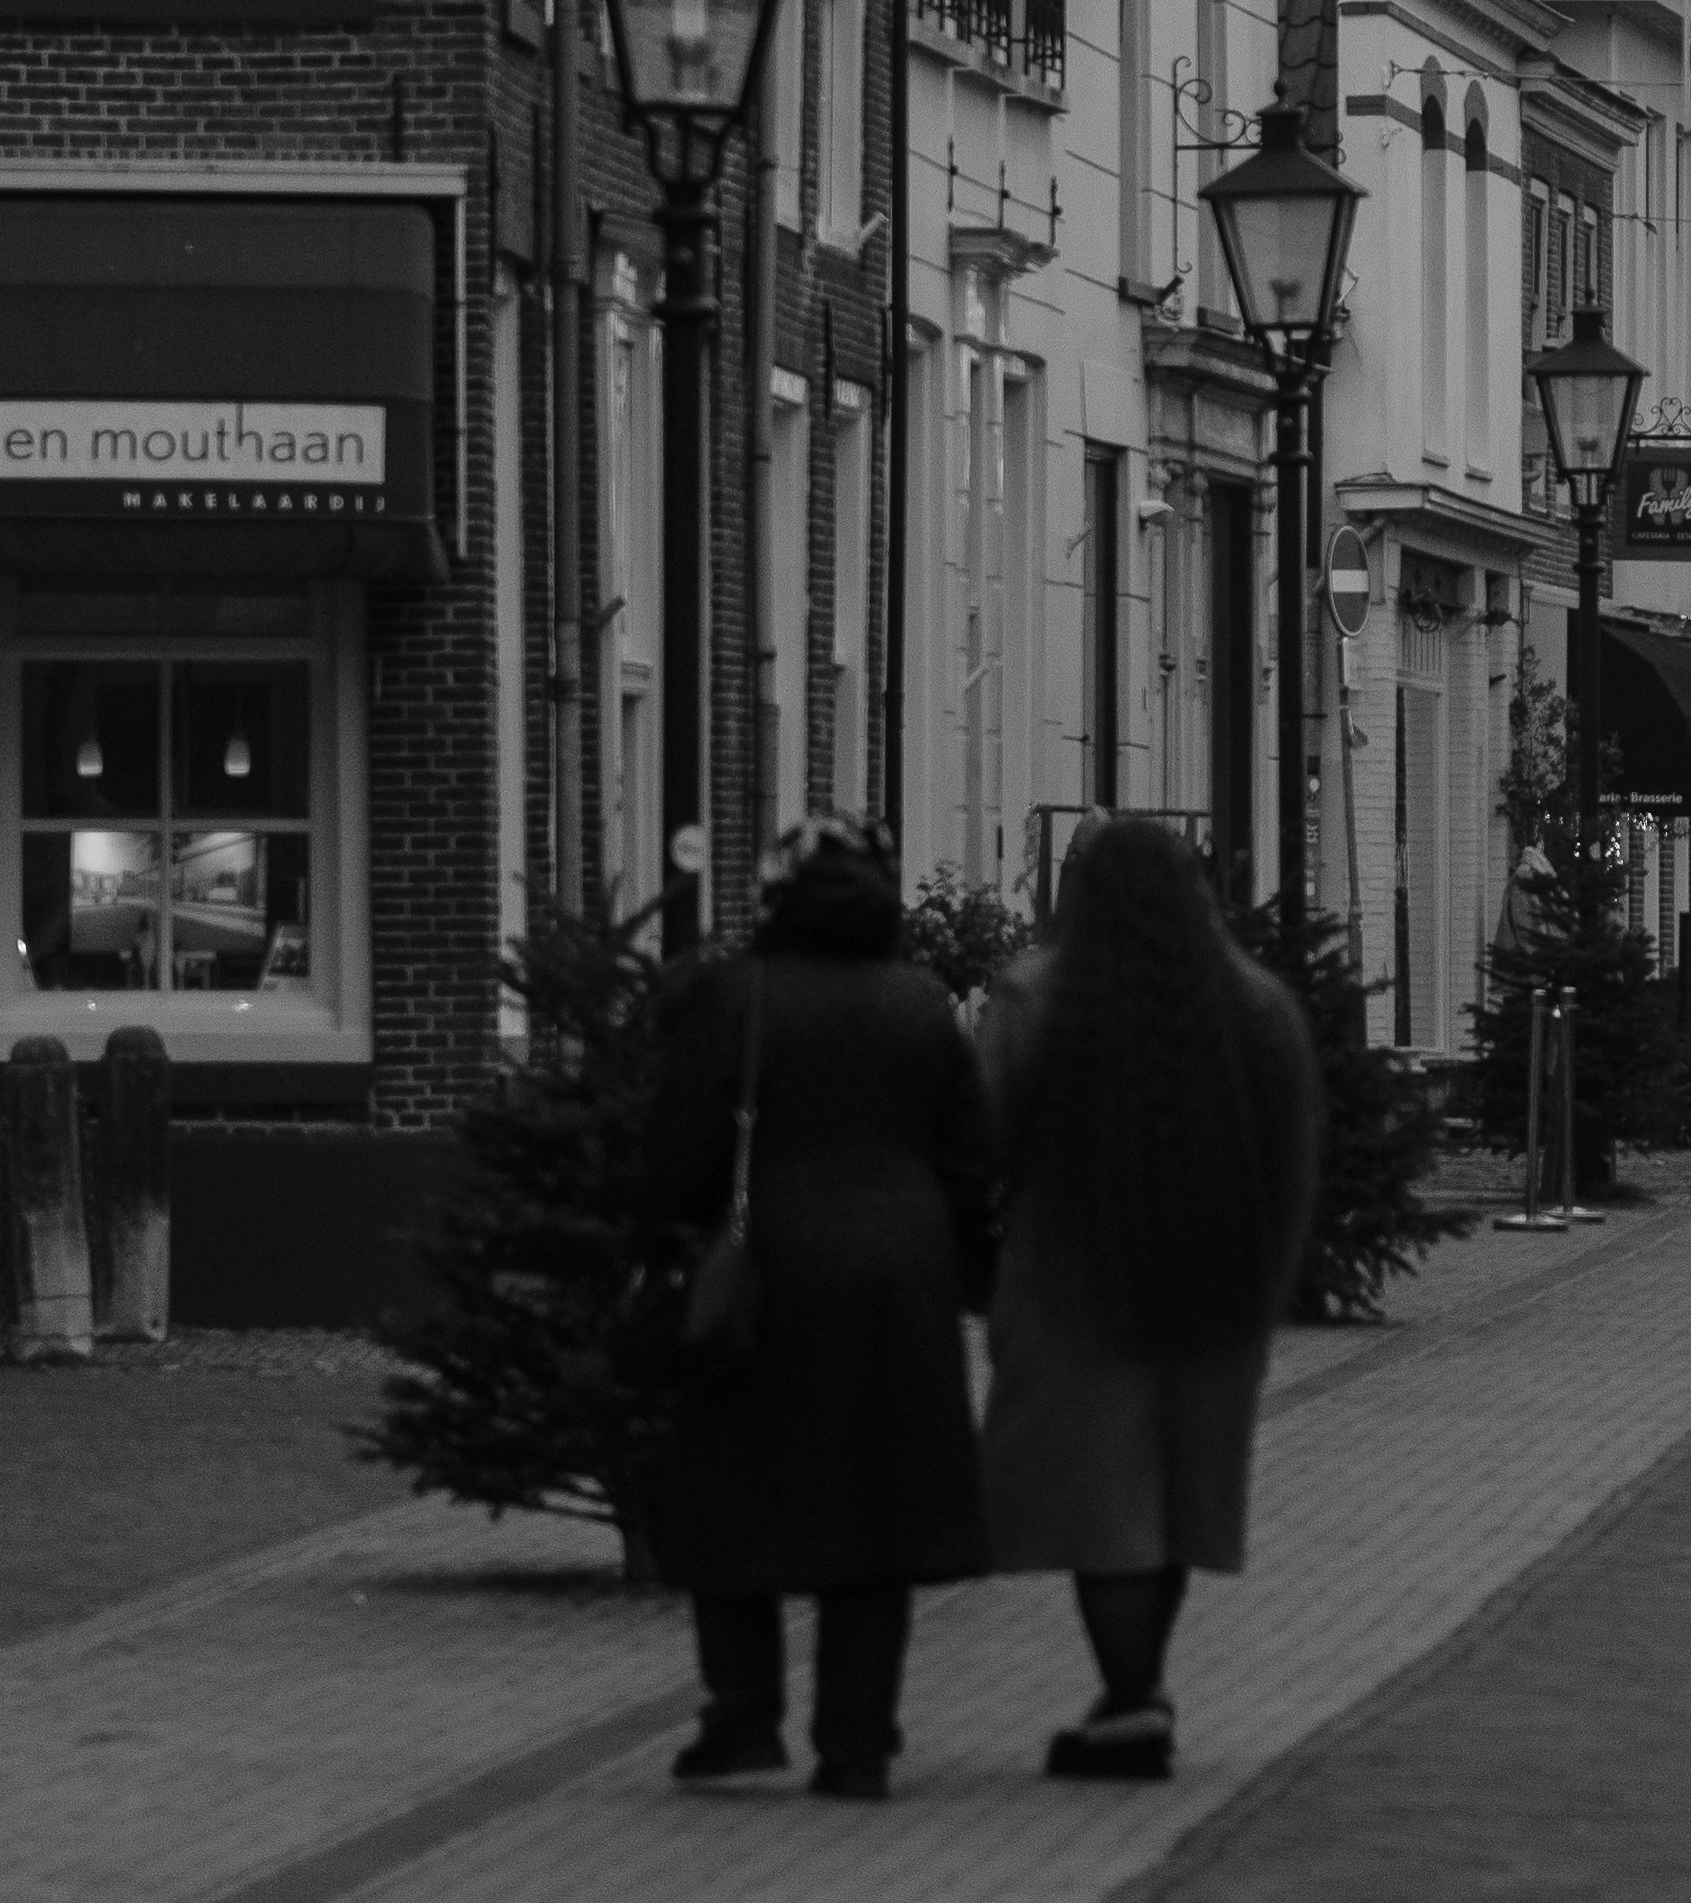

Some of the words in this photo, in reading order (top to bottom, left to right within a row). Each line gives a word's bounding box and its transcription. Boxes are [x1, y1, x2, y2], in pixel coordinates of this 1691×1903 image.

[4, 428, 68, 461] en
[91, 403, 365, 464] mouthaan
[123, 492, 385, 512] MAKELAARDIJ
[1630, 791, 1683, 804] Brasserie
